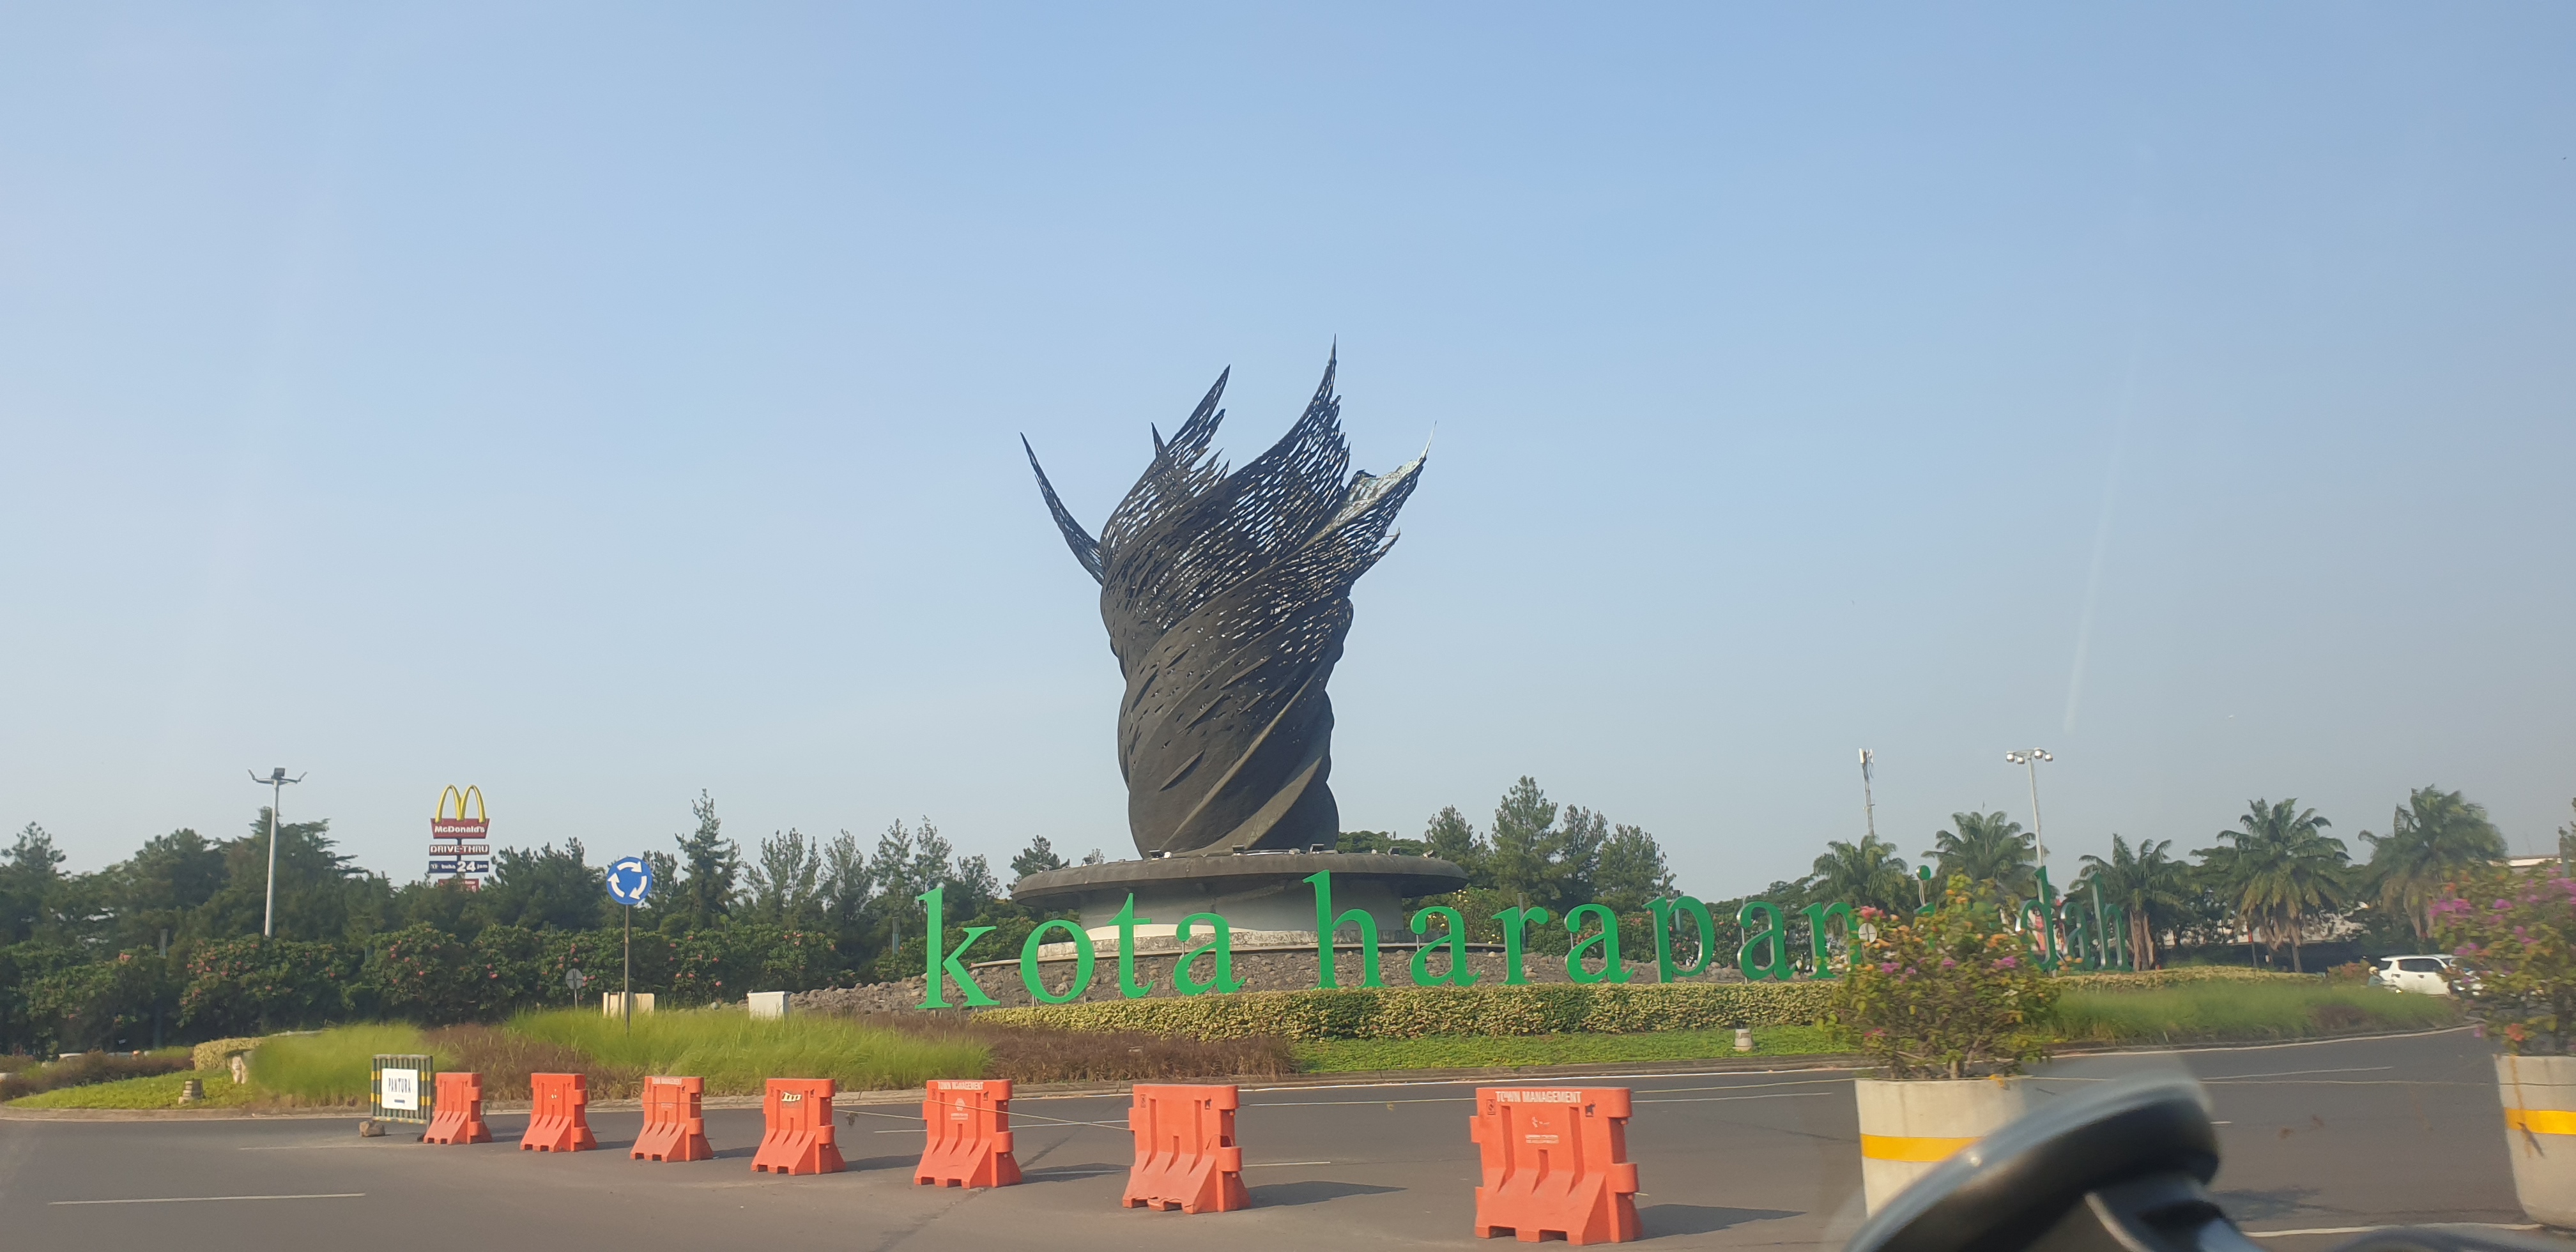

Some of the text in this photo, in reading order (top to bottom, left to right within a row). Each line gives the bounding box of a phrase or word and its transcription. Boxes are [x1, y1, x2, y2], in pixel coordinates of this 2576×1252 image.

[430, 845, 488, 853] DRIVE-THRU
[457, 860, 476, 873] 24
[915, 887, 1245, 1009] kota
[1302, 869, 1863, 989] harapan
[388, 1077, 411, 1094] PANTURA
[1495, 1091, 1583, 1103] TOWN MANAGEMENT
